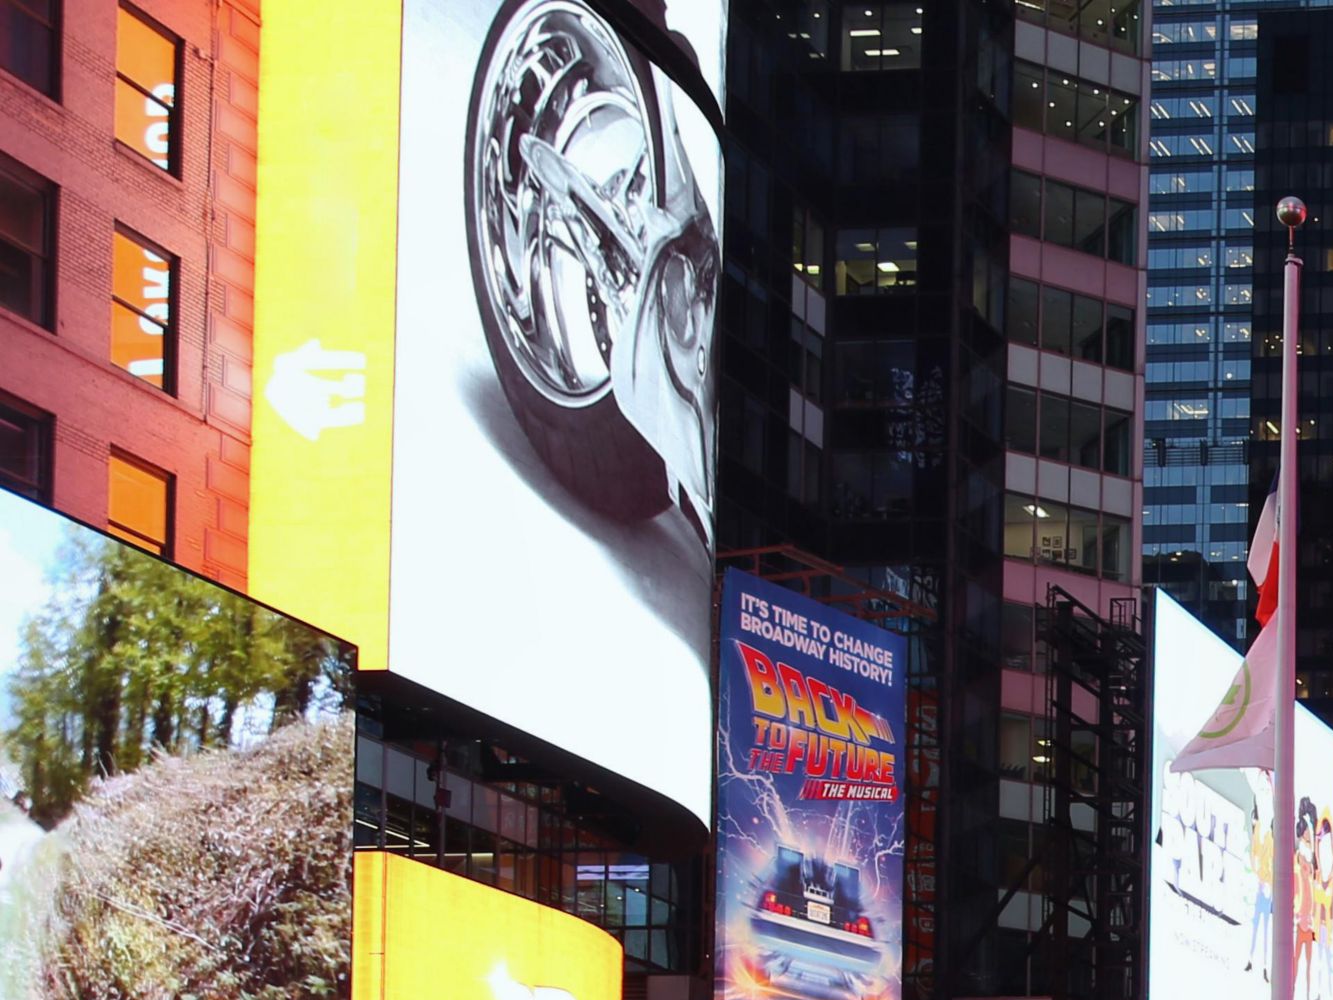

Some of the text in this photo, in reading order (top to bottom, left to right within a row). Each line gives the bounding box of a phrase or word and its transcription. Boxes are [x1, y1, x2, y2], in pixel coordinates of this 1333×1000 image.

[740, 612, 893, 687] BROADWAY HISTORY!
[741, 592, 893, 668] IT'S TIME TO CHANGE
[736, 640, 871, 745] BACK
[748, 727, 895, 785] THE FUTURE
[754, 717, 787, 750] TO
[822, 783, 893, 799] THE MUSICAL
